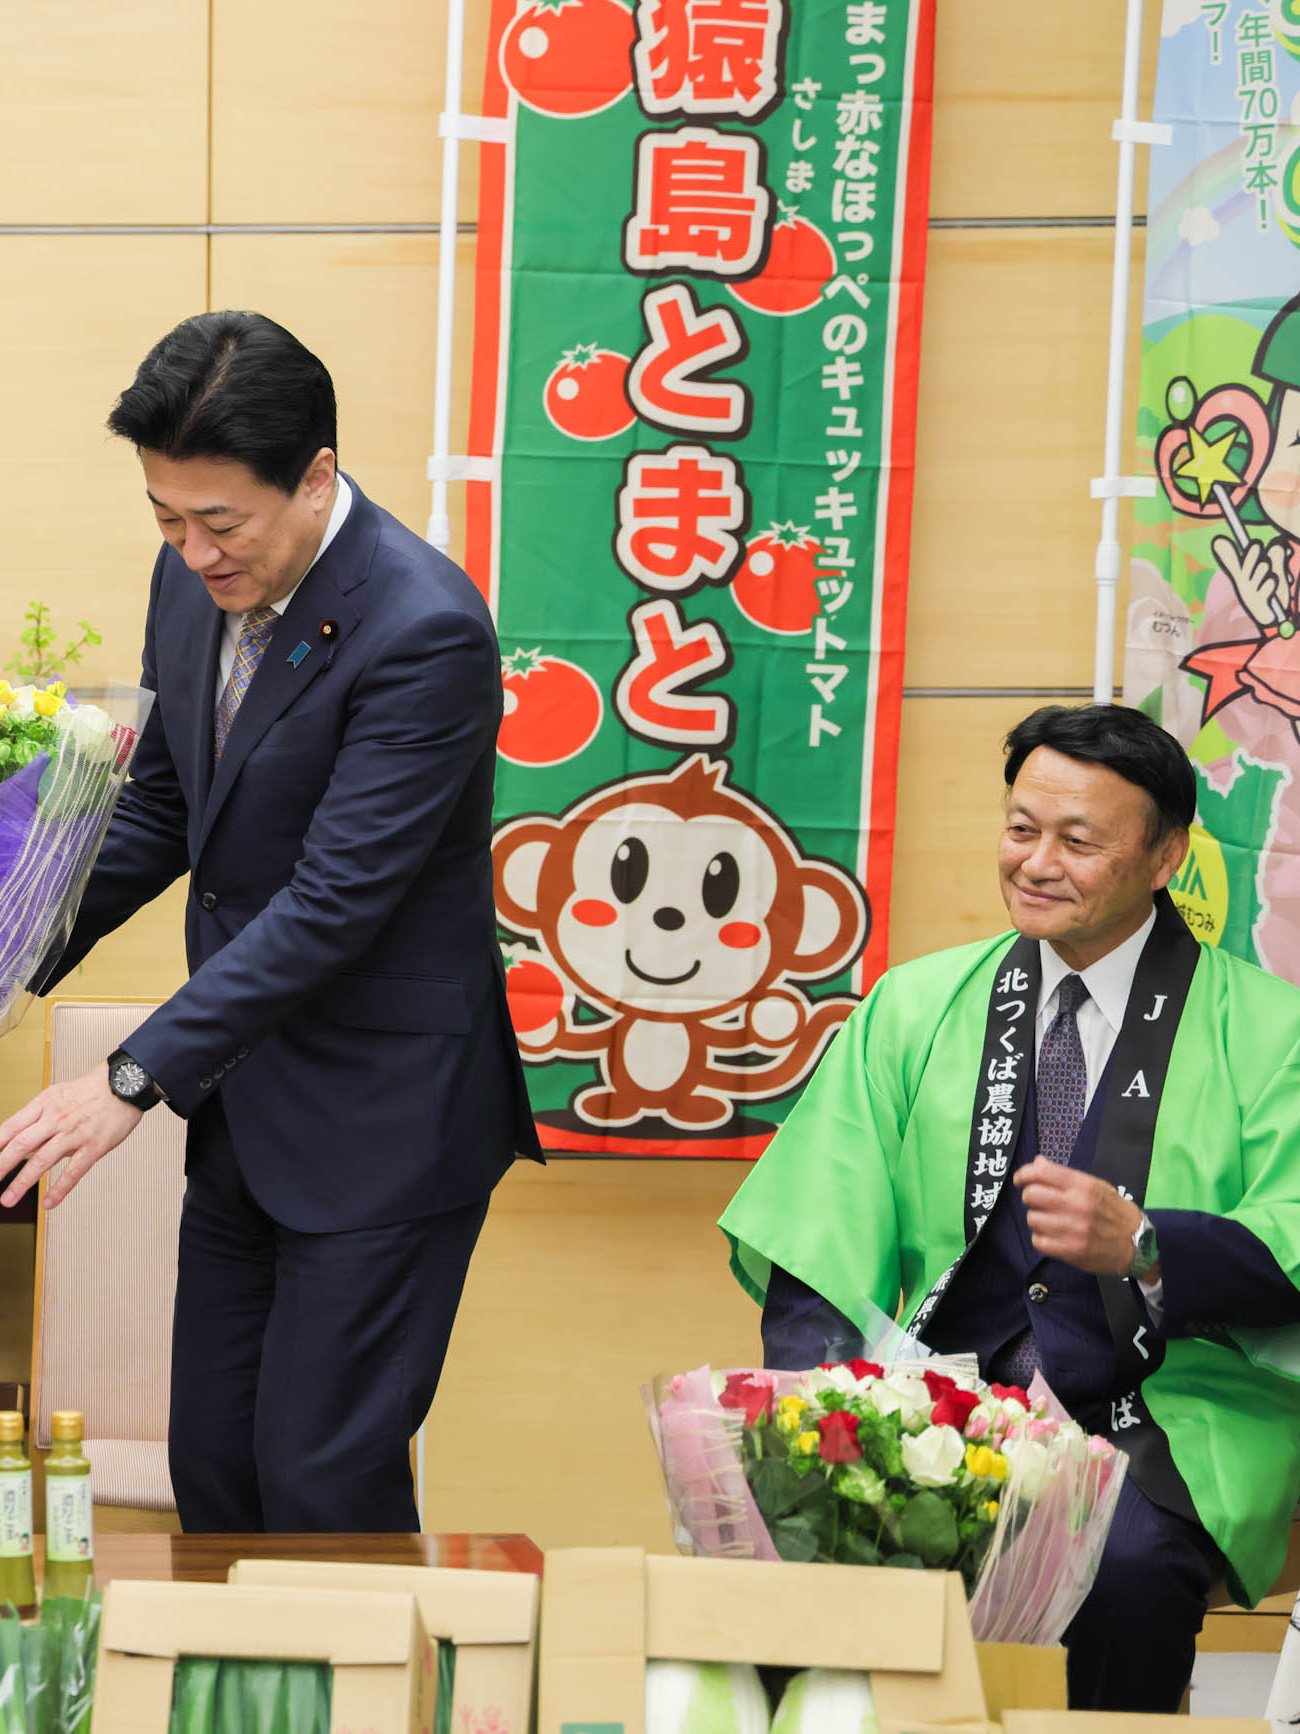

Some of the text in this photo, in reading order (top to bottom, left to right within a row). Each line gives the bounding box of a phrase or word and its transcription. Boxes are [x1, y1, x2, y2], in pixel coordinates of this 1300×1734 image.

[786, 77, 823, 193] さしま
[805, 2, 887, 748] まっ赤なほっぺのキュッキュットマト
